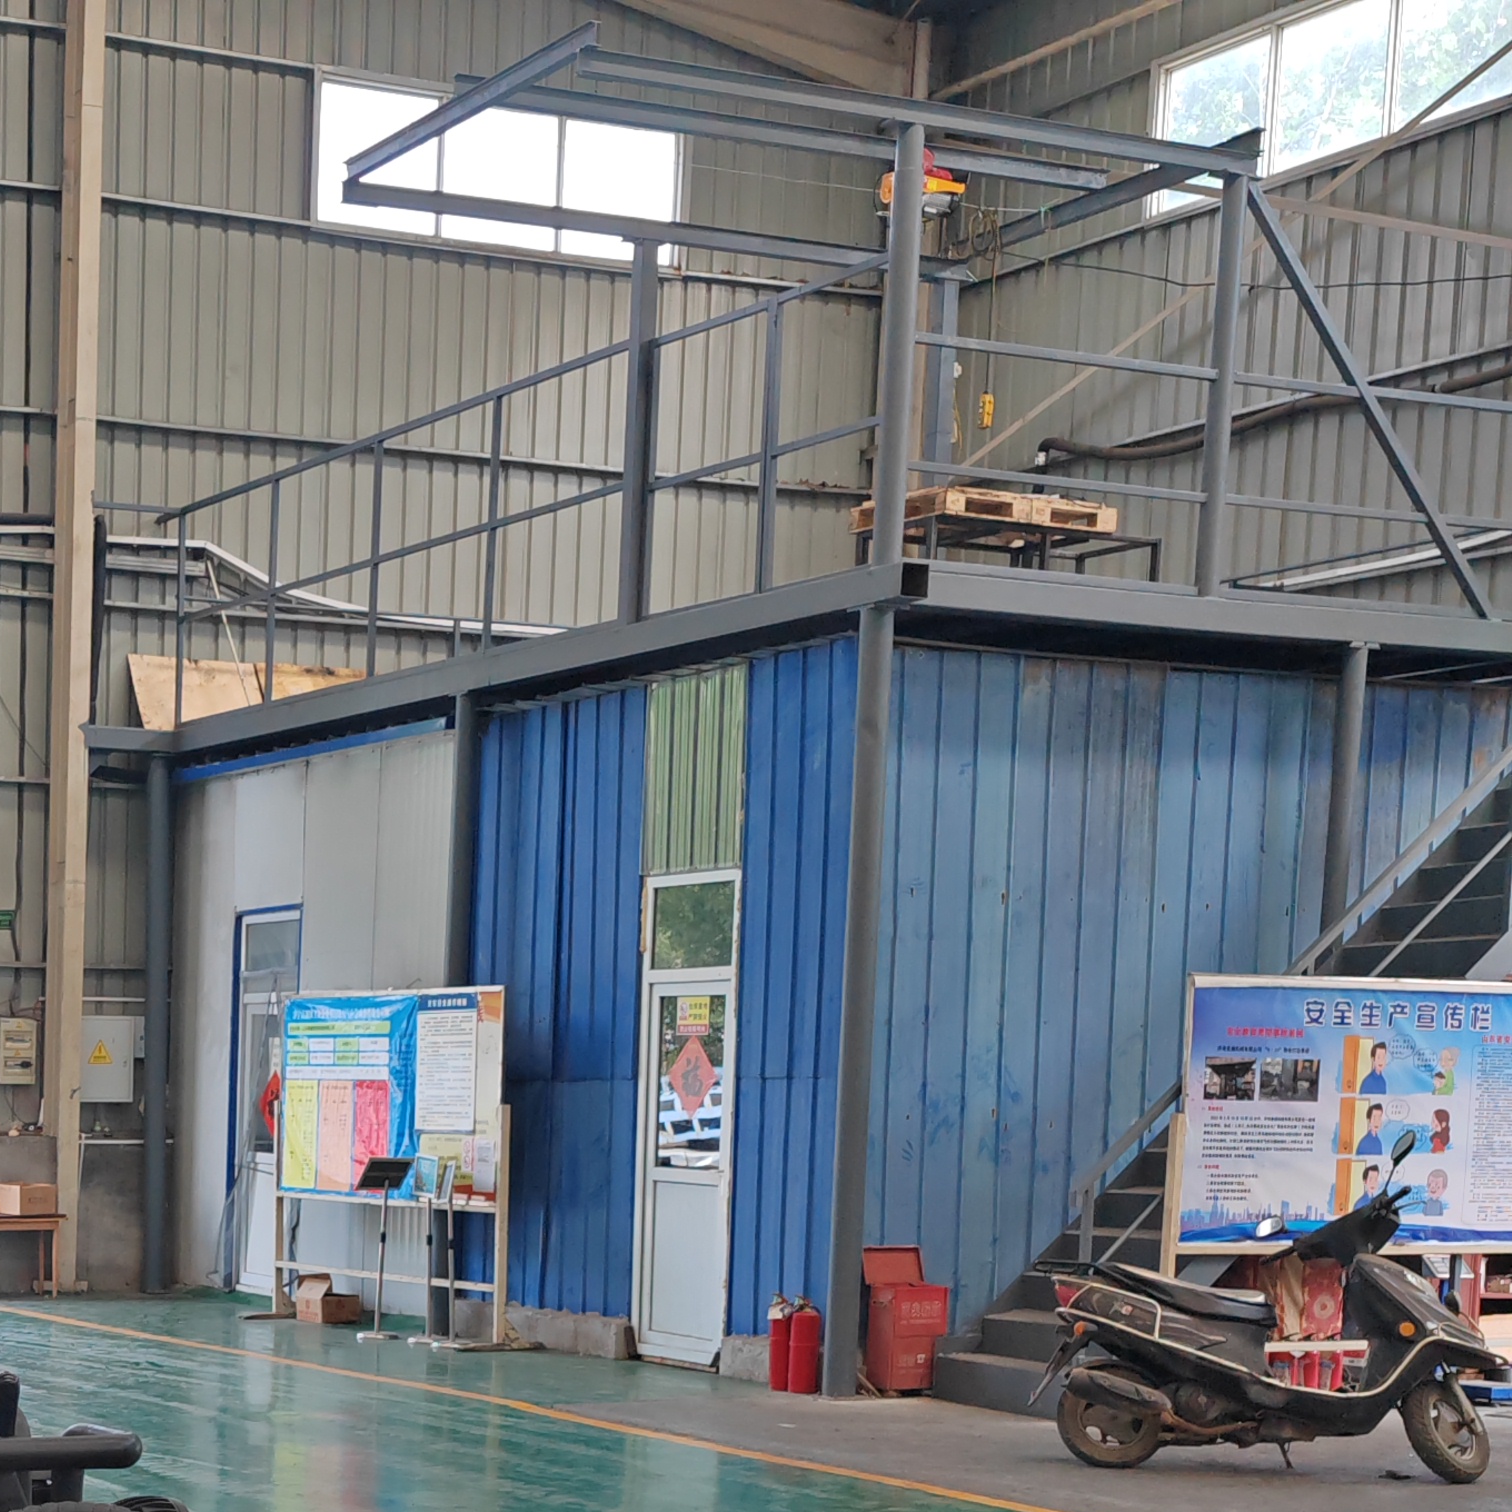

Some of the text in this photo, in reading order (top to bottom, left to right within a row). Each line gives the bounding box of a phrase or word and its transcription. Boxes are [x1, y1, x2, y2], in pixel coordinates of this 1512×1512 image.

[1304, 999, 1491, 1031] 安全生产宣传栏
